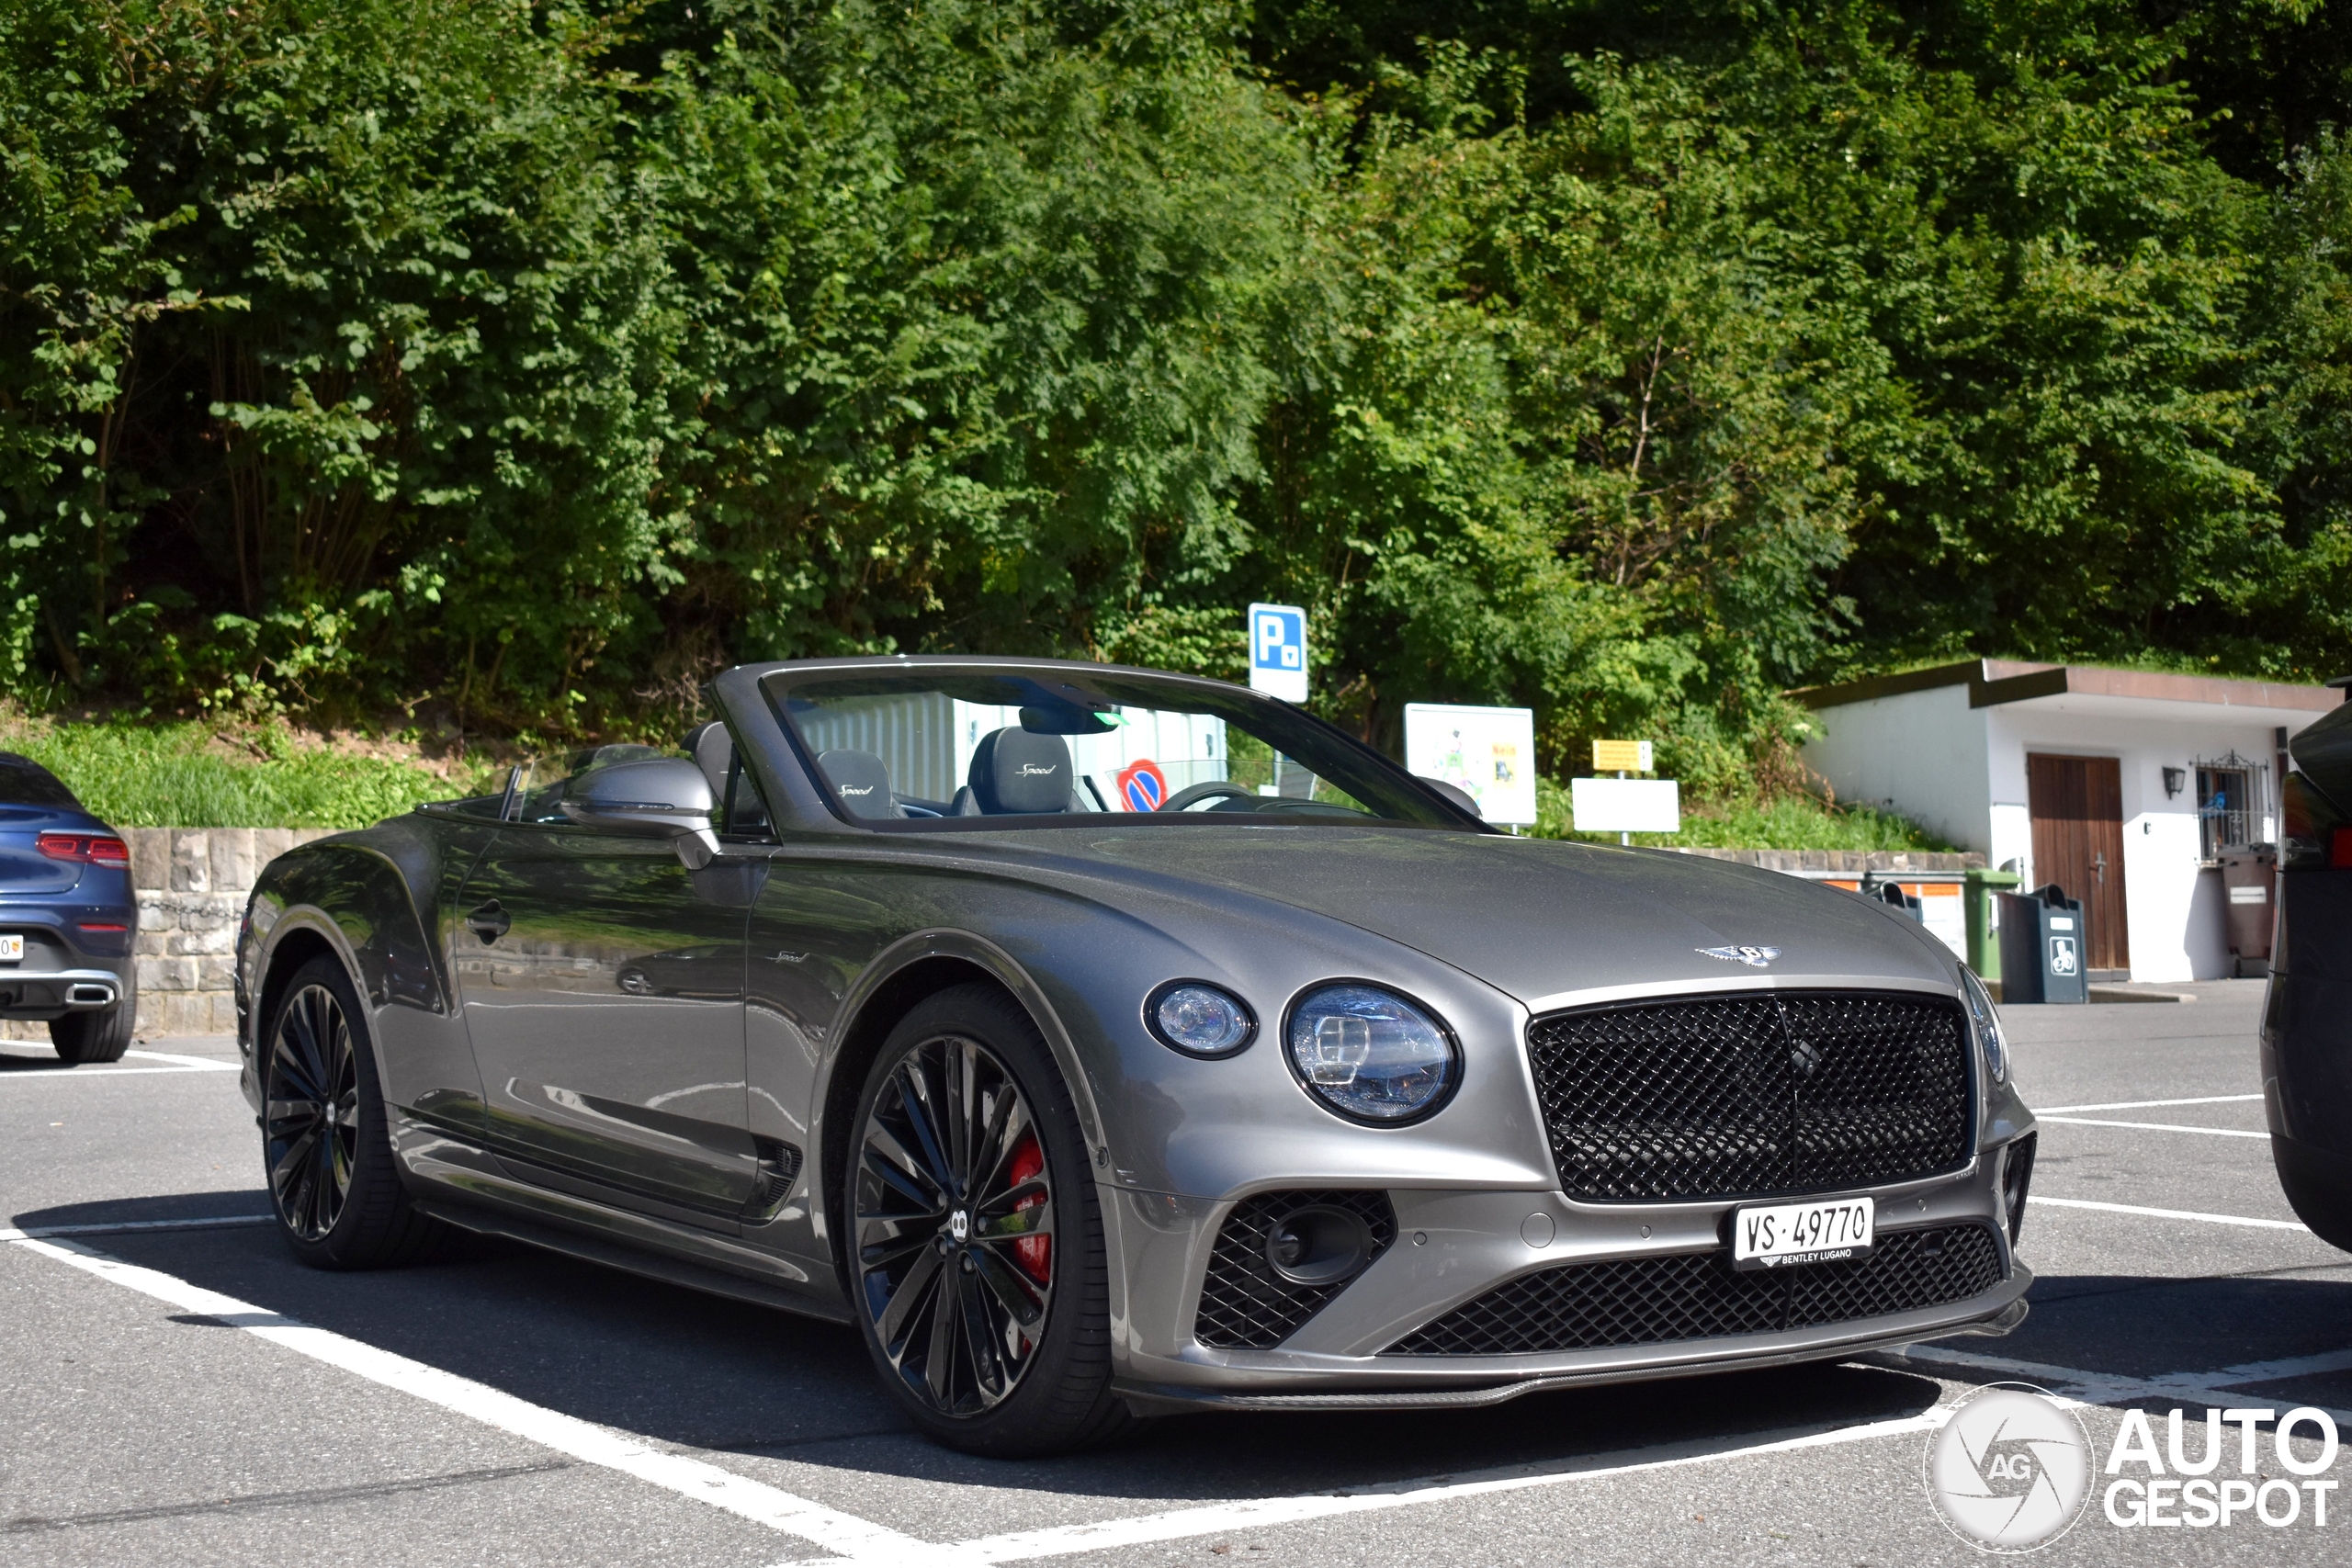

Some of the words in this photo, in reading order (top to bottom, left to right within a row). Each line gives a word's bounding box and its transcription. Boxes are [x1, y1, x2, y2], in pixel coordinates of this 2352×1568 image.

[1258, 615, 1284, 661] P
[1492, 745, 1516, 756] Nein
[1015, 763, 1057, 777] Speed
[837, 784, 874, 797] Speed
[1781, 1252, 1819, 1265] BENTLEY
[1820, 1248, 1852, 1260] LUGANO
